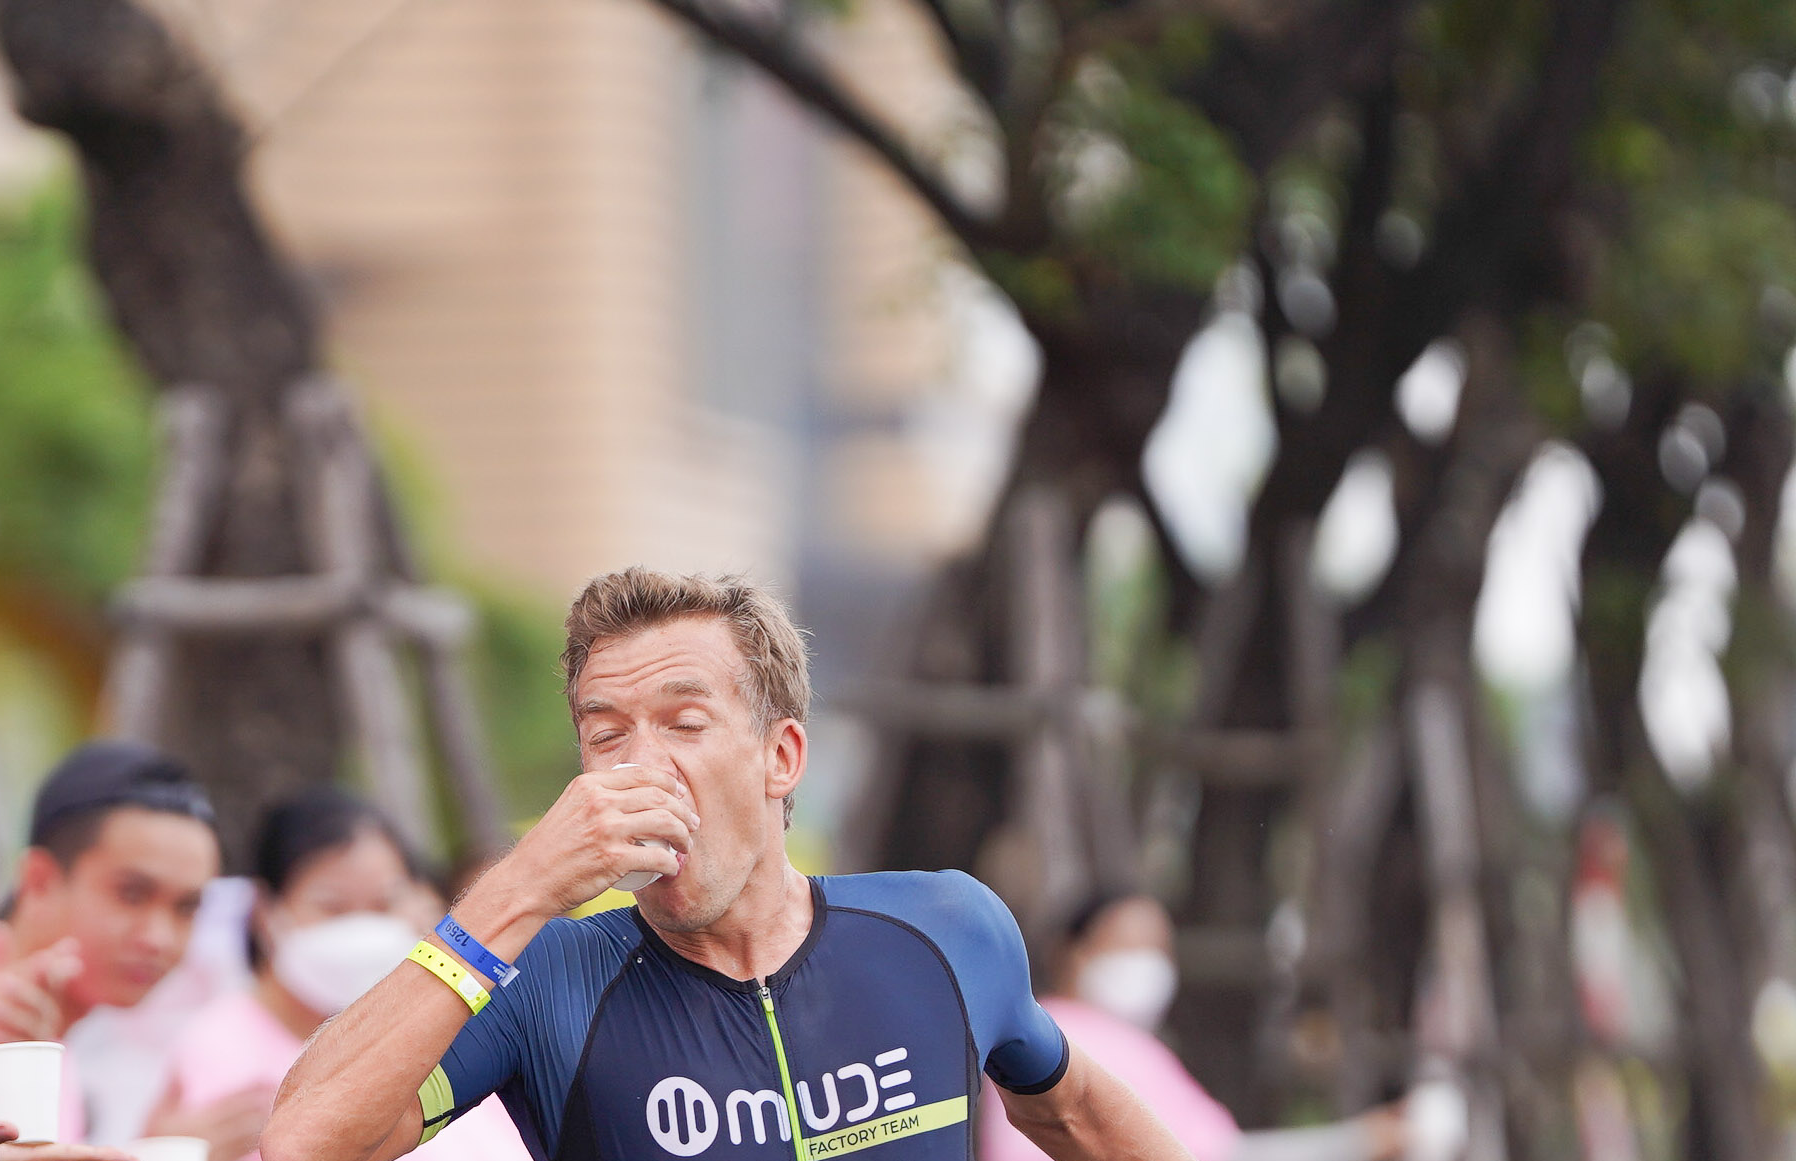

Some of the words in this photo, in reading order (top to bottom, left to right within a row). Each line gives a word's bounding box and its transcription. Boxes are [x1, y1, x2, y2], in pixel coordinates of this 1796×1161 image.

[445, 921, 471, 947] 1259
[808, 1126, 877, 1156] FACTORY
[881, 1114, 920, 1136] TEAM
